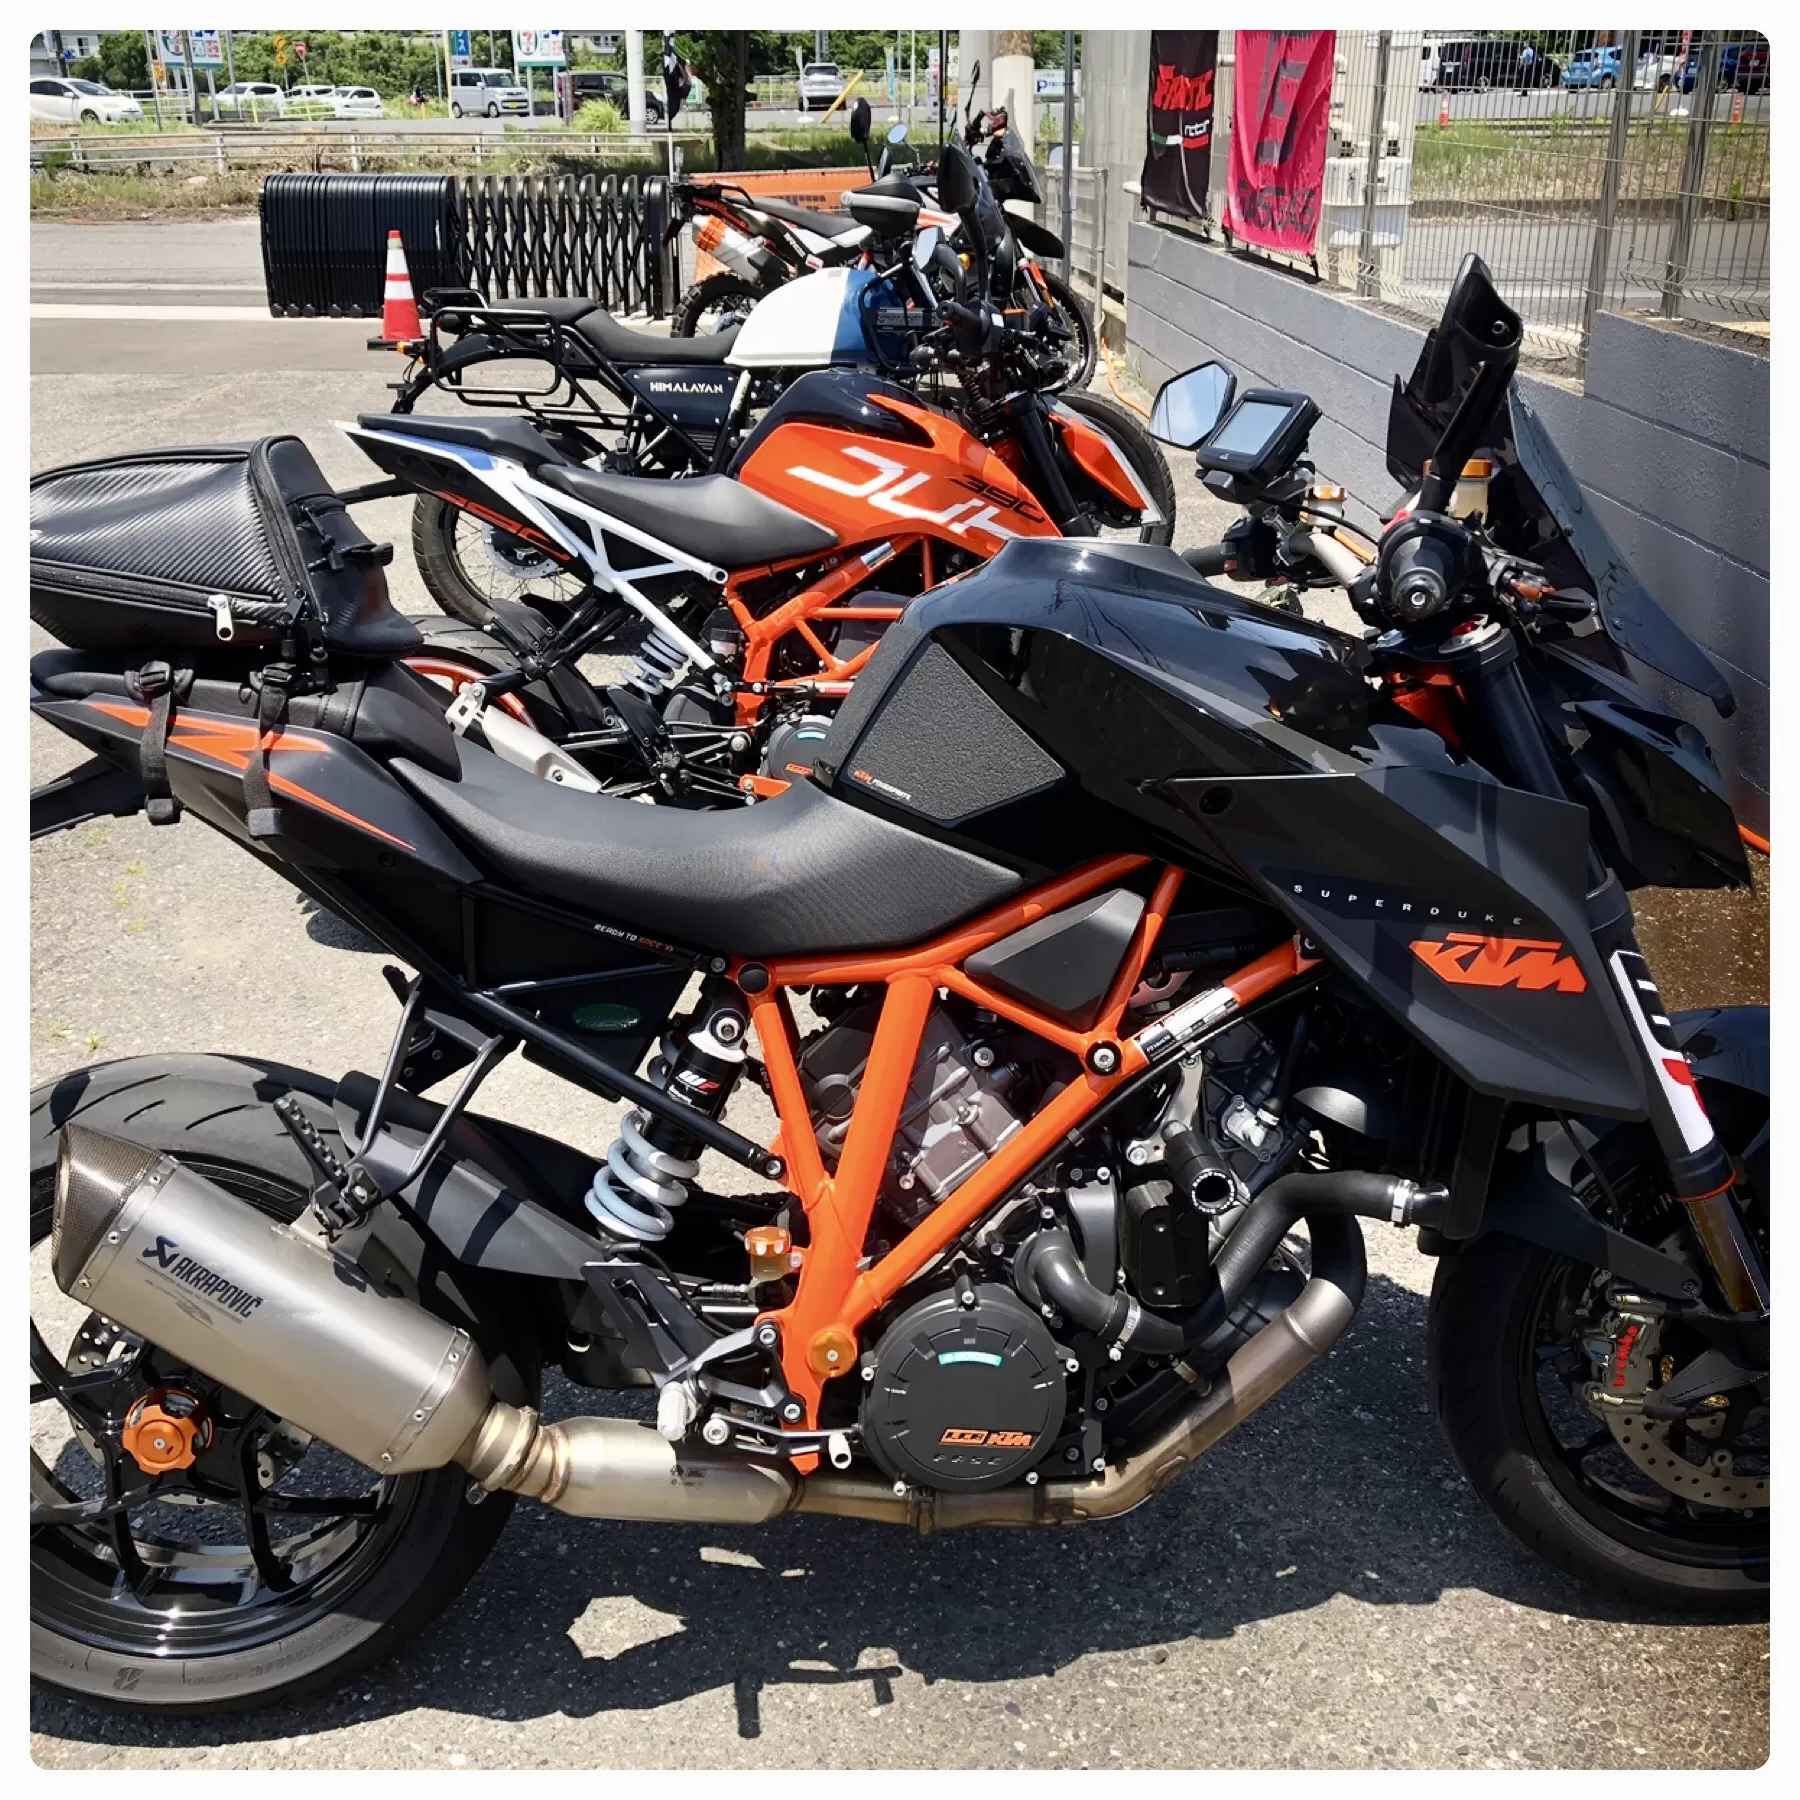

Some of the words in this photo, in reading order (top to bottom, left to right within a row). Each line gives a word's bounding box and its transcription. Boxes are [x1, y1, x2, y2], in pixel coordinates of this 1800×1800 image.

[650, 381, 723, 394] HIMALAYAN
[785, 446, 1020, 539] DUK
[594, 923, 624, 938] READY
[626, 931, 638, 942] TO
[1409, 932, 1588, 995] KTM
[986, 1431, 1033, 1446] KTM
